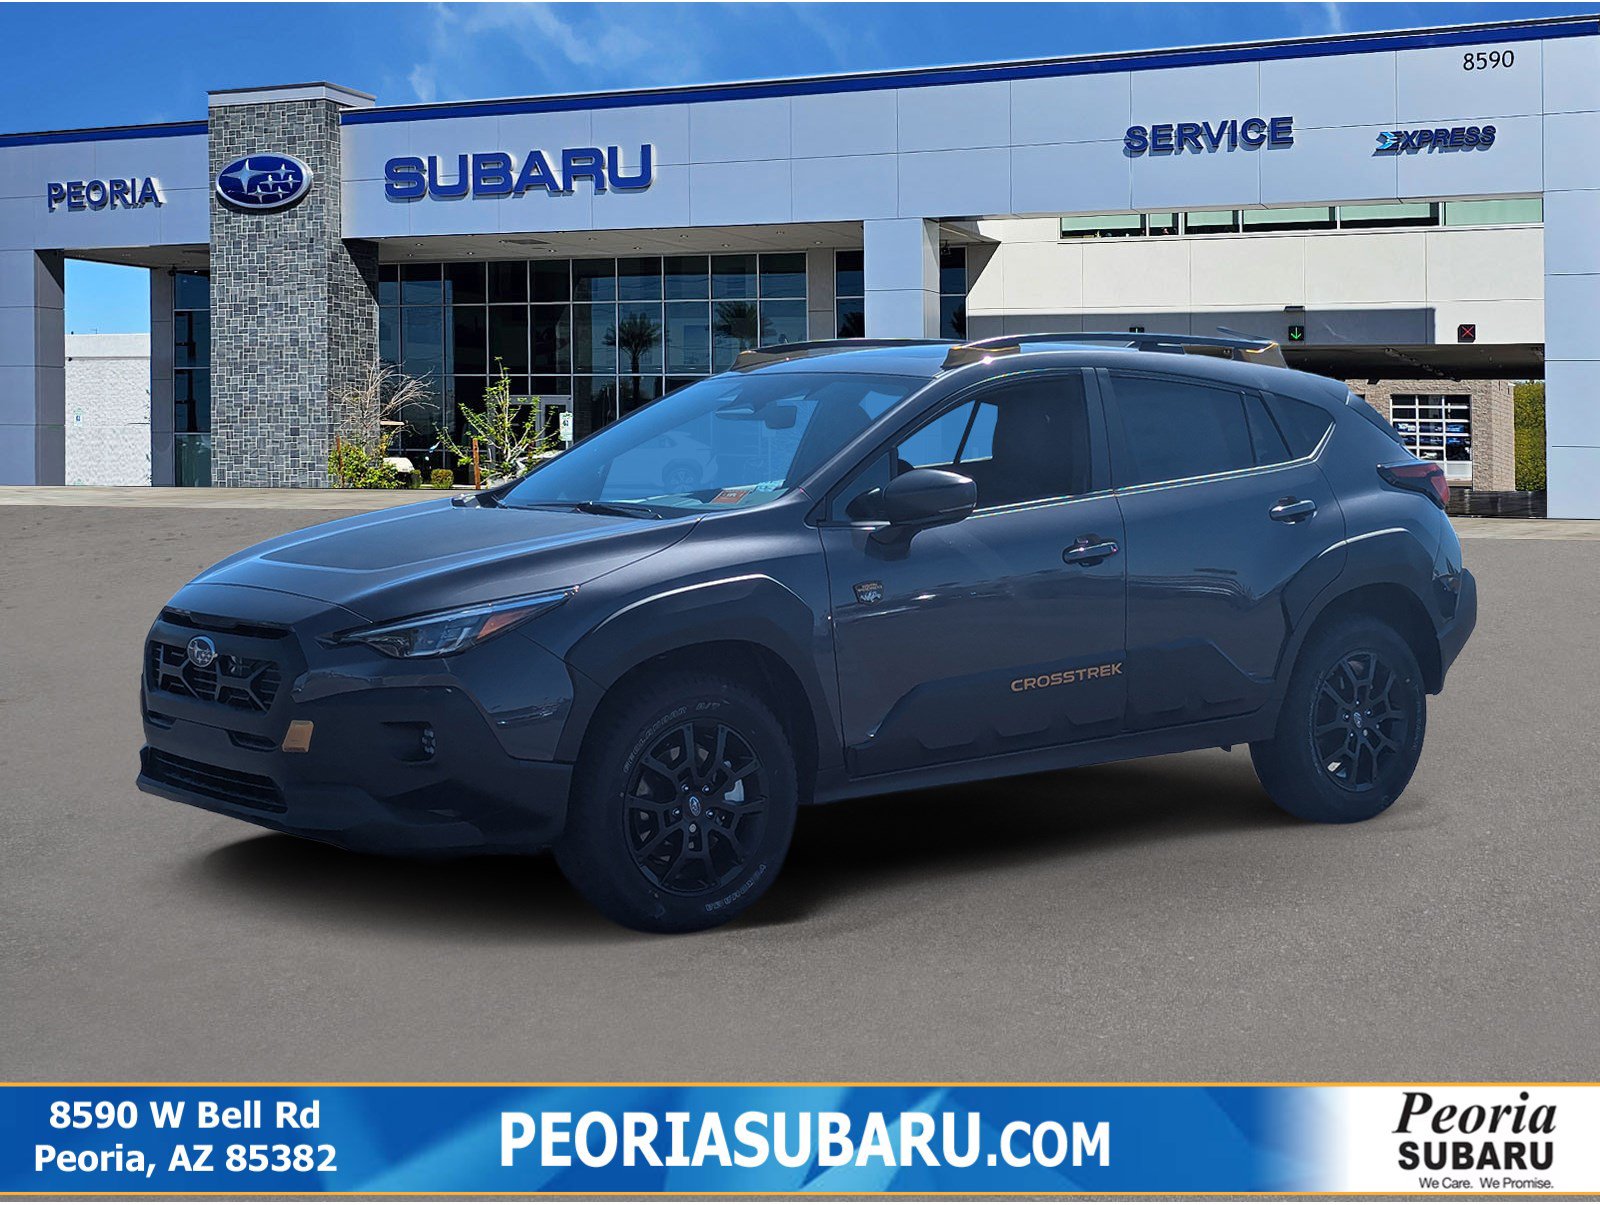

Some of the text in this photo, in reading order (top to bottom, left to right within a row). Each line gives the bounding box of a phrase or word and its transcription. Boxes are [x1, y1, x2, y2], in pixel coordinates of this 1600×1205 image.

[1463, 50, 1515, 71] 8590
[1124, 116, 1294, 154] SERVICE
[1376, 125, 1497, 153] EXPRESS
[384, 144, 653, 200] SUBARU
[47, 177, 163, 212] PEORIA
[1010, 662, 1123, 693] CROSSTREK
